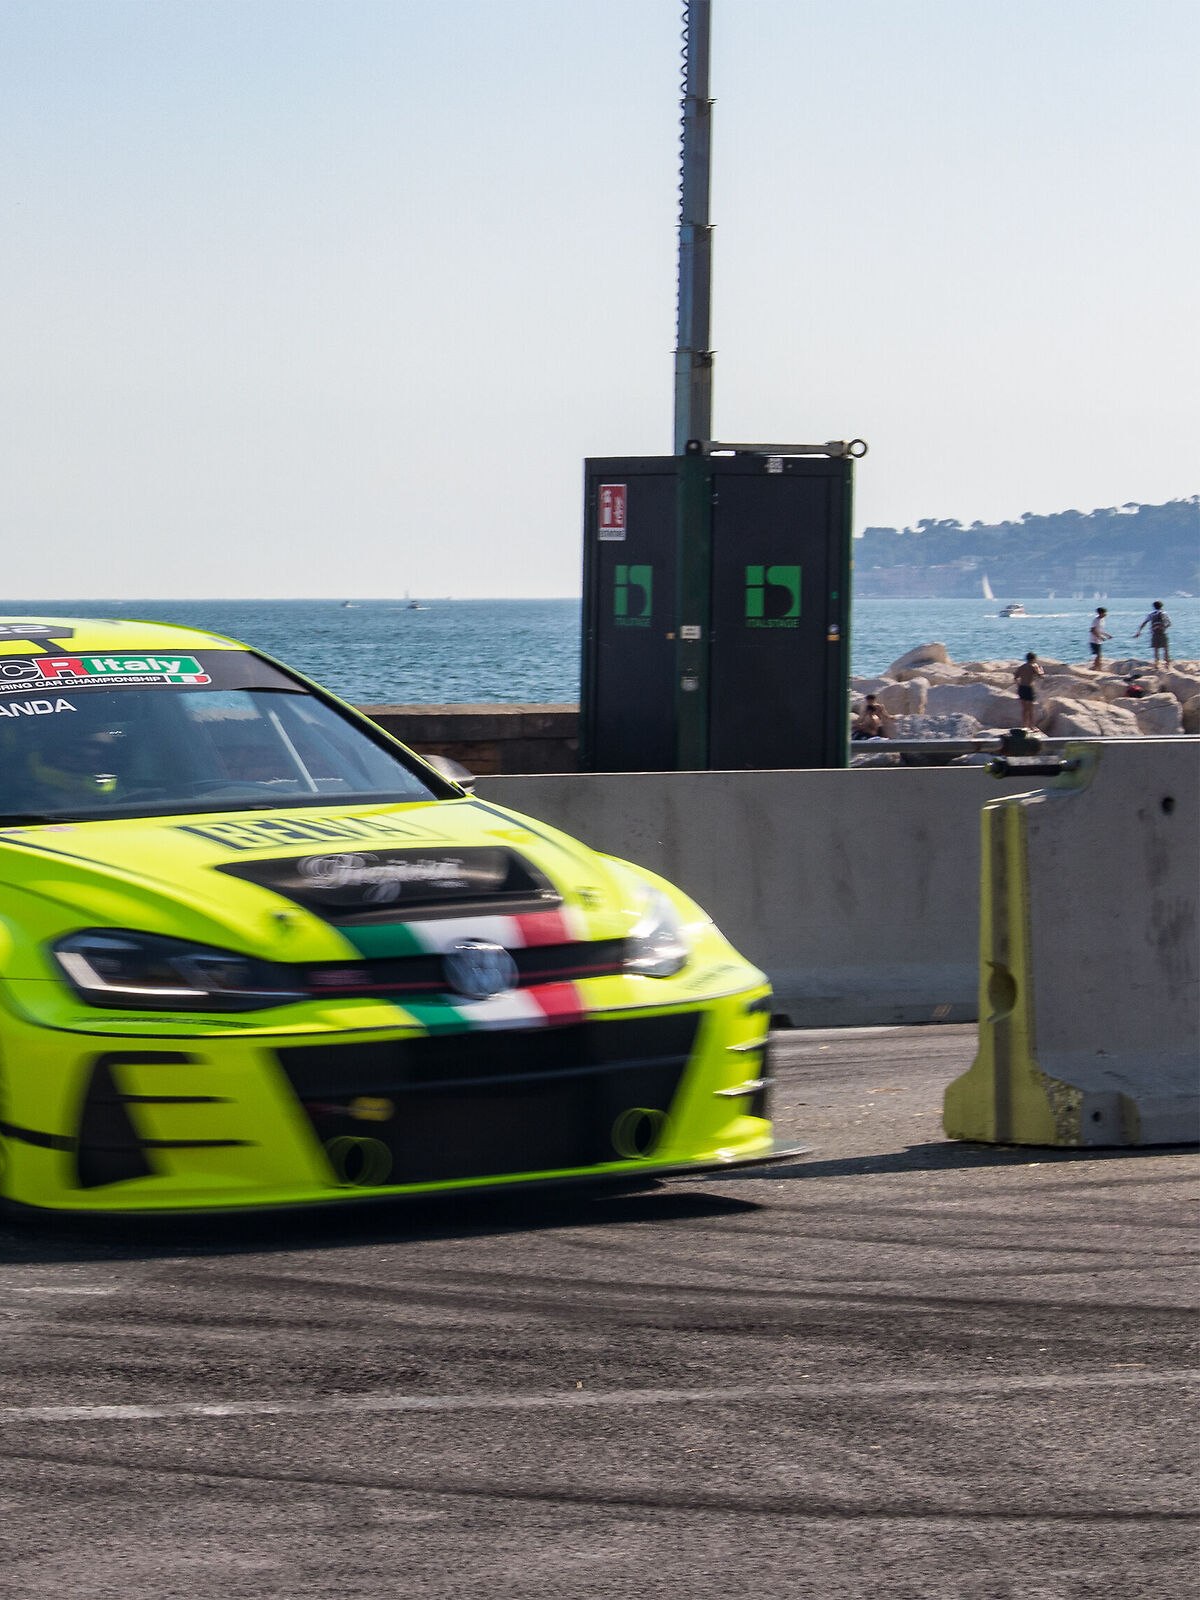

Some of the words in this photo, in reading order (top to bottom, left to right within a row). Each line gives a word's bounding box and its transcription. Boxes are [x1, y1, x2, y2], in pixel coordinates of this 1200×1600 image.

[90, 658, 181, 673] Italy
[35, 678, 63, 688] CAR
[64, 675, 162, 686] CHAMPIONSHIP
